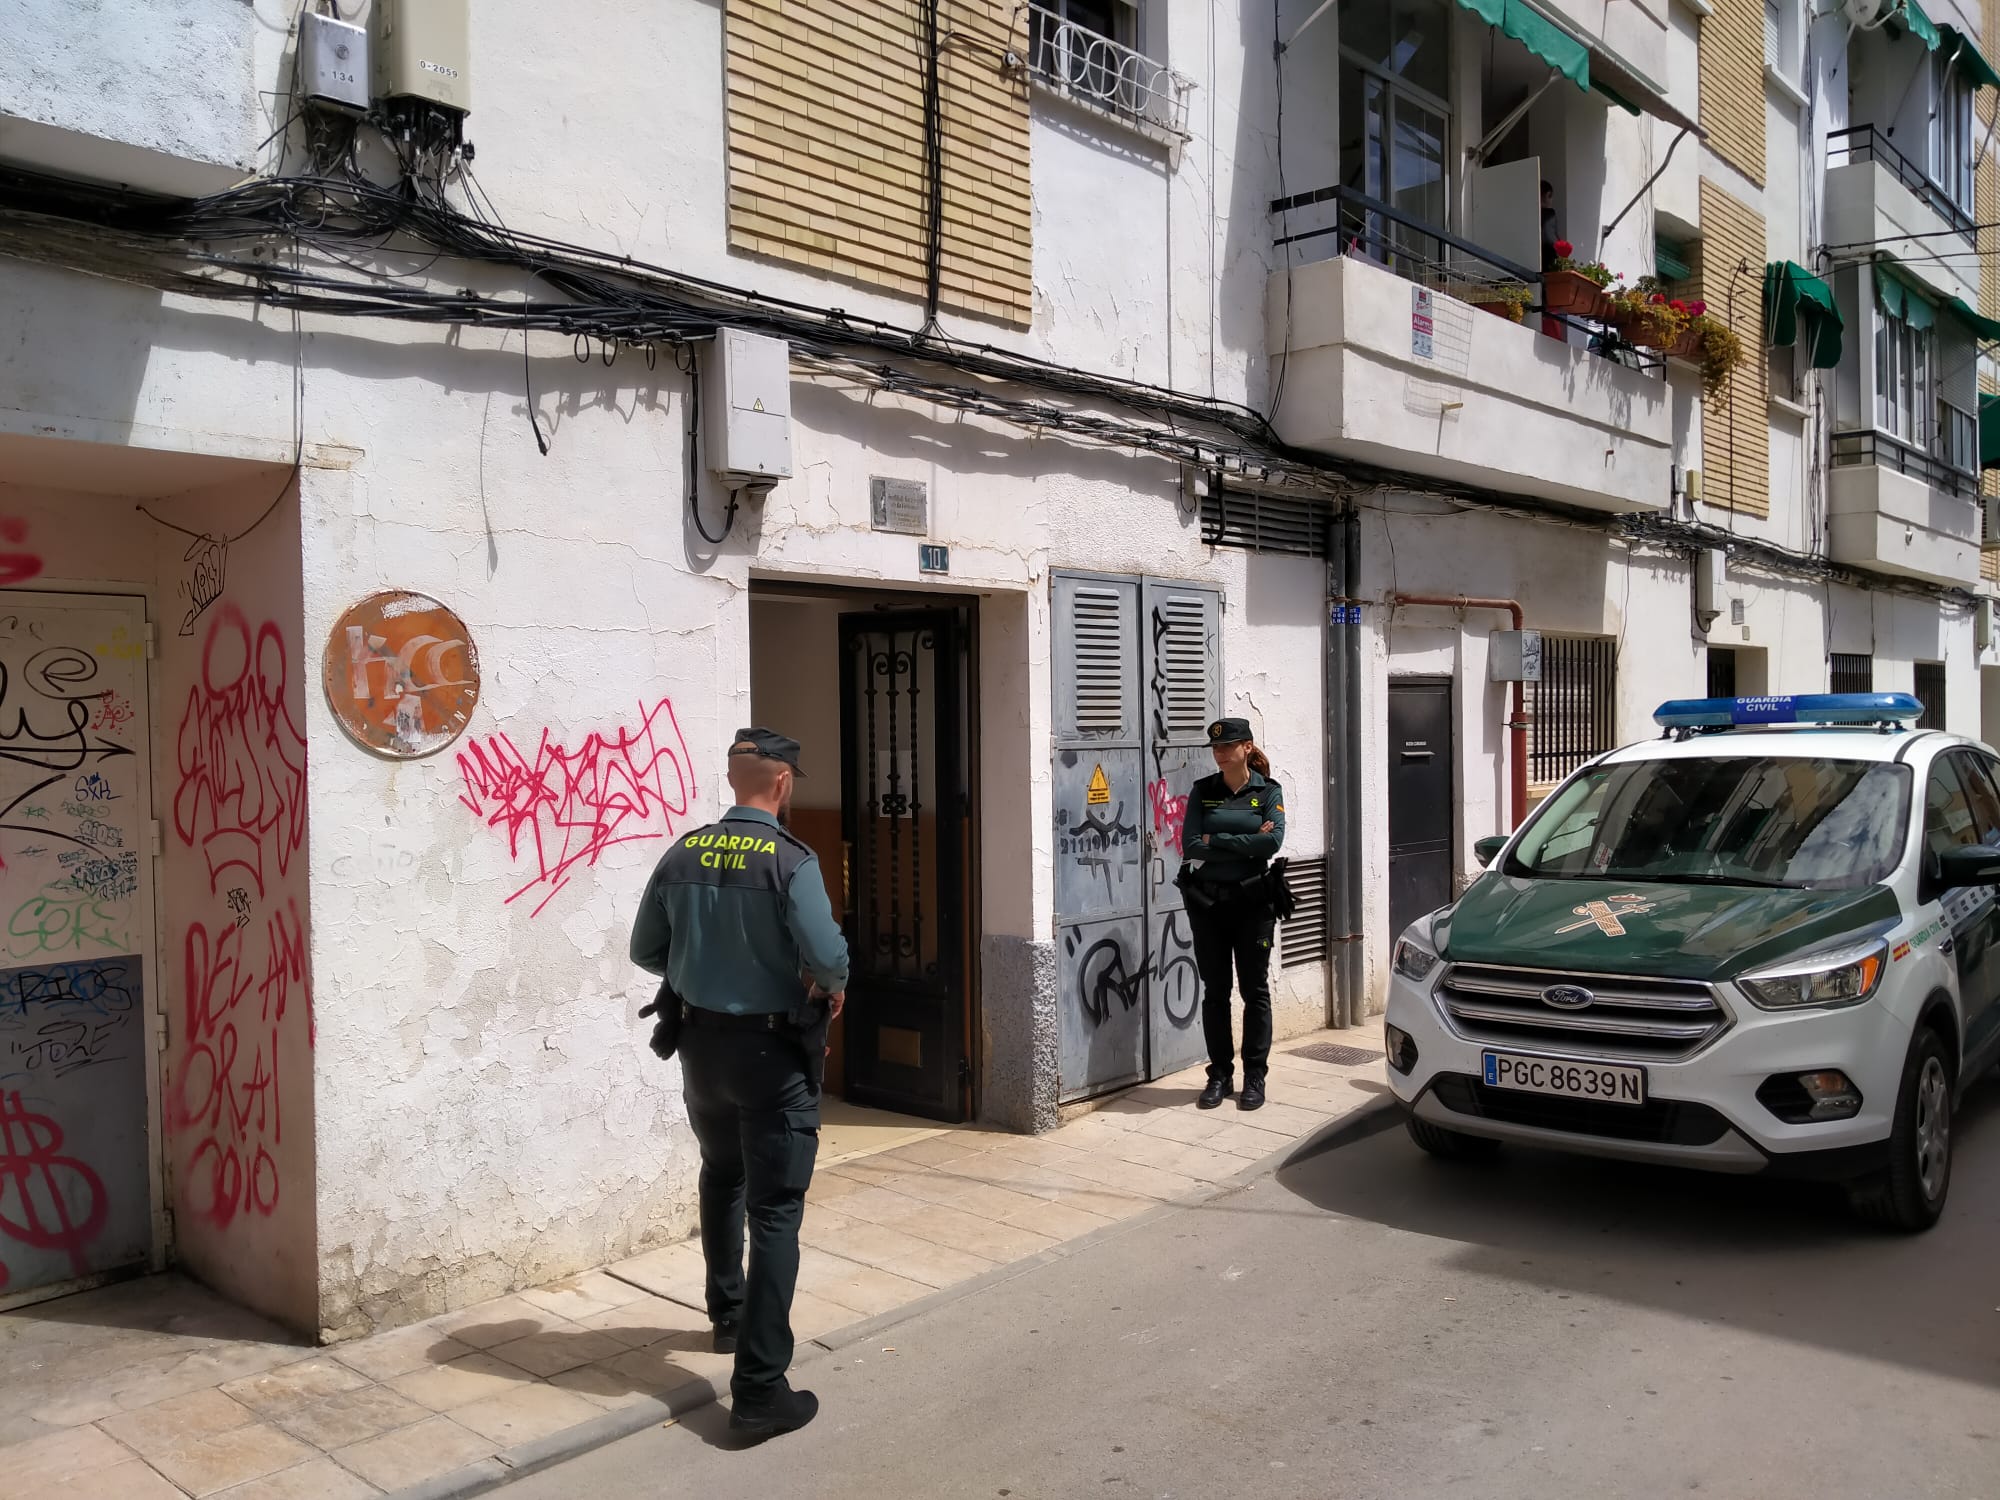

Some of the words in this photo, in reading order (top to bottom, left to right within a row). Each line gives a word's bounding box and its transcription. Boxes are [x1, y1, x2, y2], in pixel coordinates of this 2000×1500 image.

[332, 70, 354, 83] 134
[928, 547, 941, 569] 10
[1736, 696, 1792, 704] GUARDIA
[1745, 703, 1779, 712] CIVIL
[684, 834, 777, 855] GUARDIA
[700, 851, 747, 870] CIVIL
[1551, 988, 1580, 1004] Ford
